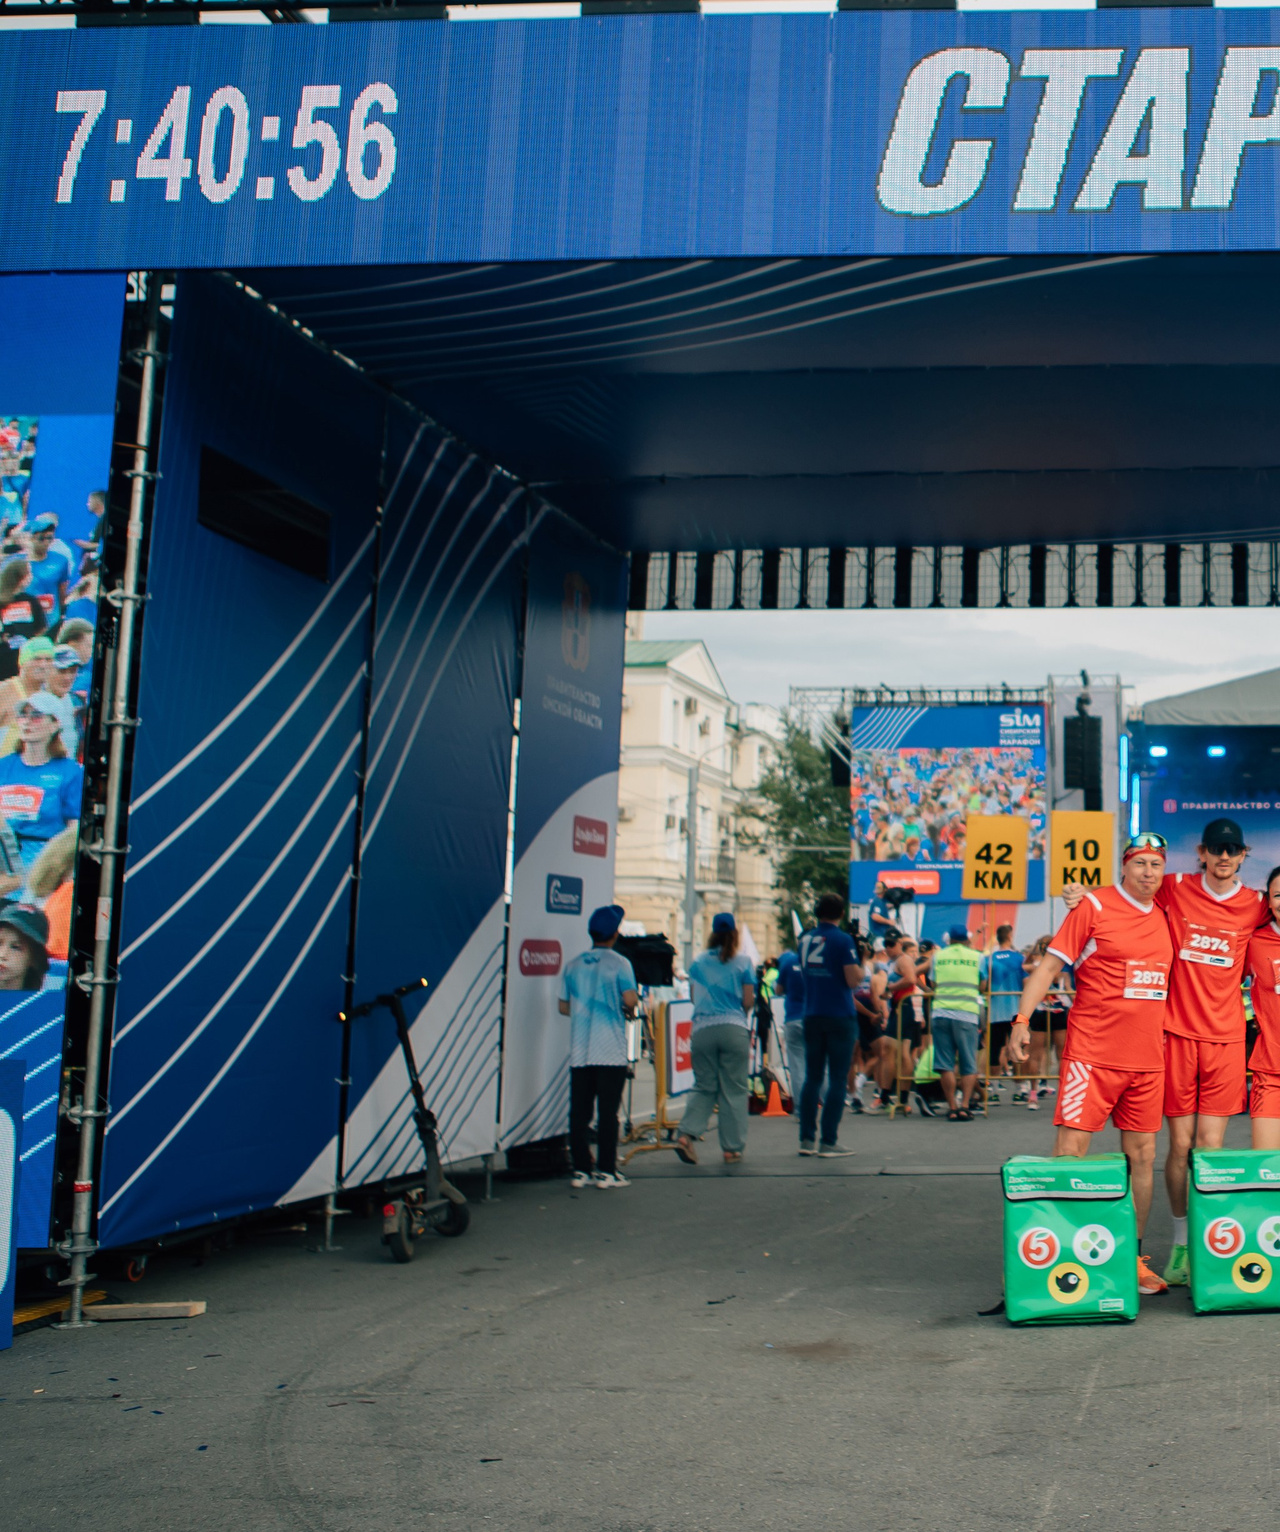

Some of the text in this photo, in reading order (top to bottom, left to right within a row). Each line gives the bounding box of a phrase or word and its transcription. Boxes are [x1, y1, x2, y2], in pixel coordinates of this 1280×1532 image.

[55, 81, 399, 205] 7:40:56
[1182, 802, 1271, 810] ПРАВИТЕЛЬСТВО
[975, 843, 1013, 865] 42
[1064, 839, 1100, 861] 10
[974, 870, 1013, 890] КМ
[1189, 933, 1230, 953] 2874
[937, 959, 978, 967] REFEREE
[1131, 970, 1166, 986] 2873
[1200, 1168, 1245, 1176] Доставляем
[1200, 1176, 1236, 1184] продукты
